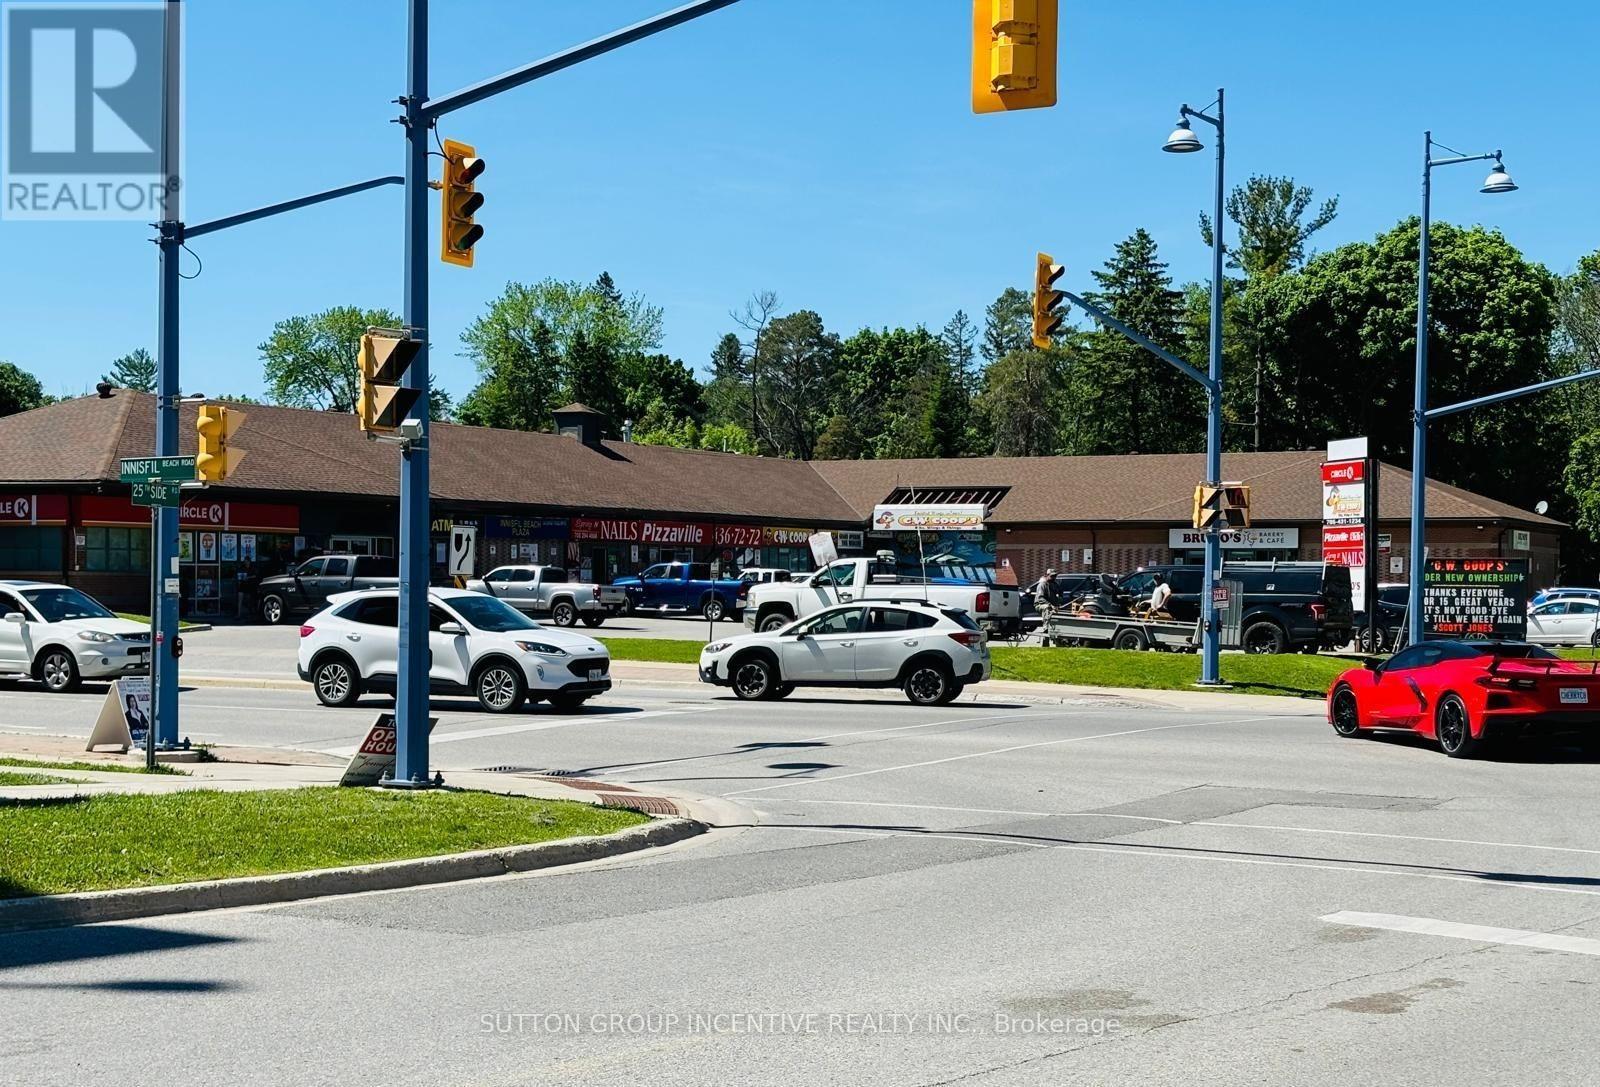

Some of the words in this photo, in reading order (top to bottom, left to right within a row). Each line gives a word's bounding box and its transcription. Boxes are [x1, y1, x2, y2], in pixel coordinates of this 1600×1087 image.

[121, 460, 160, 475] INNISFIL
[1331, 470, 1347, 478] CIRCLE
[150, 486, 167, 499] SIDE
[0, 502, 12, 514] LE
[180, 506, 207, 519] IRCLE
[209, 505, 222, 522] K
[431, 519, 453, 532] ATM
[601, 520, 638, 541] NAILS
[512, 528, 530, 536] PLAZA
[642, 522, 703, 542] Pizzaville
[1183, 533, 1242, 543] BRUO'S
[1341, 551, 1363, 566] NAILS
[1425, 573, 1441, 581] DER
[1445, 574, 1464, 582] NEW
[1468, 573, 1519, 582] OWNERSHIP
[1424, 588, 1457, 597] THANKS
[1460, 588, 1504, 597] EVERYONE
[1424, 597, 1435, 606] OR
[1440, 597, 1449, 605] 15
[1454, 598, 1482, 606] GREAT
[1488, 598, 1515, 606] YEARS
[1424, 606, 1440, 614] IT'S
[1444, 606, 1460, 614] NOT
[1433, 615, 1451, 623] TILL
[1455, 615, 1468, 623] WE
[1472, 615, 1494, 624] MEET
[1497, 616, 1522, 624] AGAIN
[1438, 624, 1463, 632] SCOTT
[1467, 624, 1493, 632] JONES
[371, 729, 395, 742] OP
[364, 740, 396, 753] HOU
